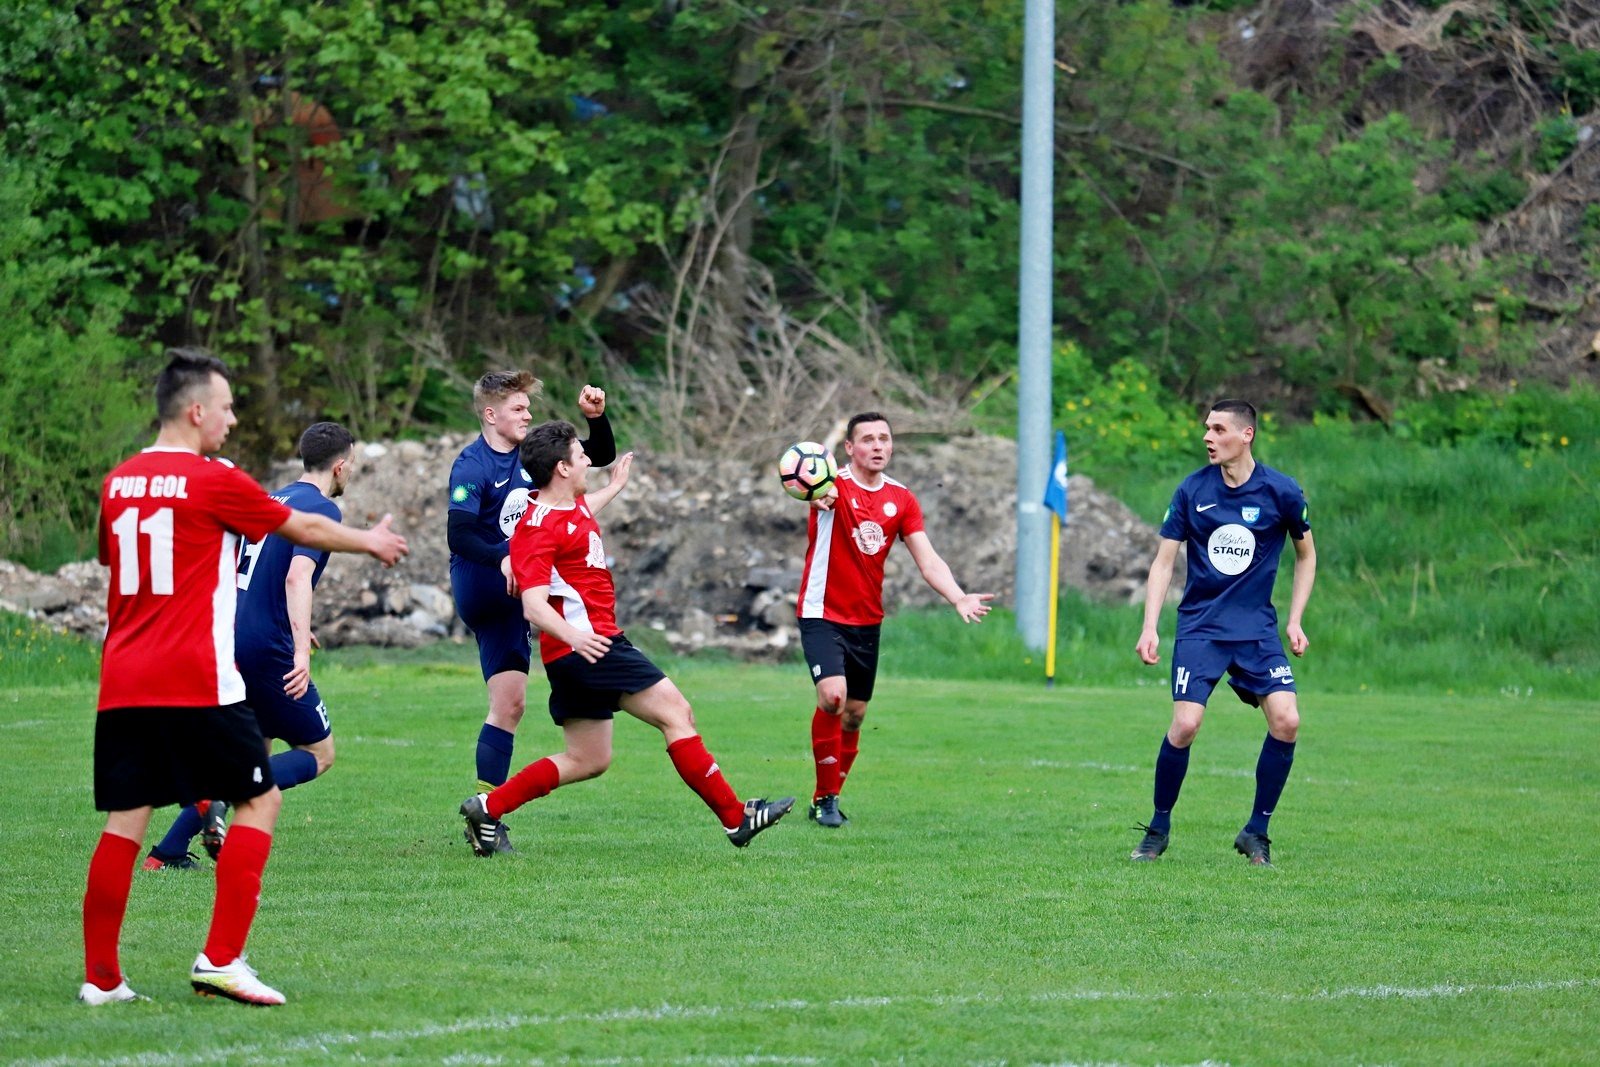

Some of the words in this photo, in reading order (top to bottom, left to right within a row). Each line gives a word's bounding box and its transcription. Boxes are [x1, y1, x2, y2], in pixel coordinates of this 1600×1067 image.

[109, 476, 147, 499] PUB
[150, 475, 188, 499] GOL
[112, 507, 174, 595] 11
[1213, 546, 1250, 558] STACJA
[1175, 666, 1190, 694] 14
